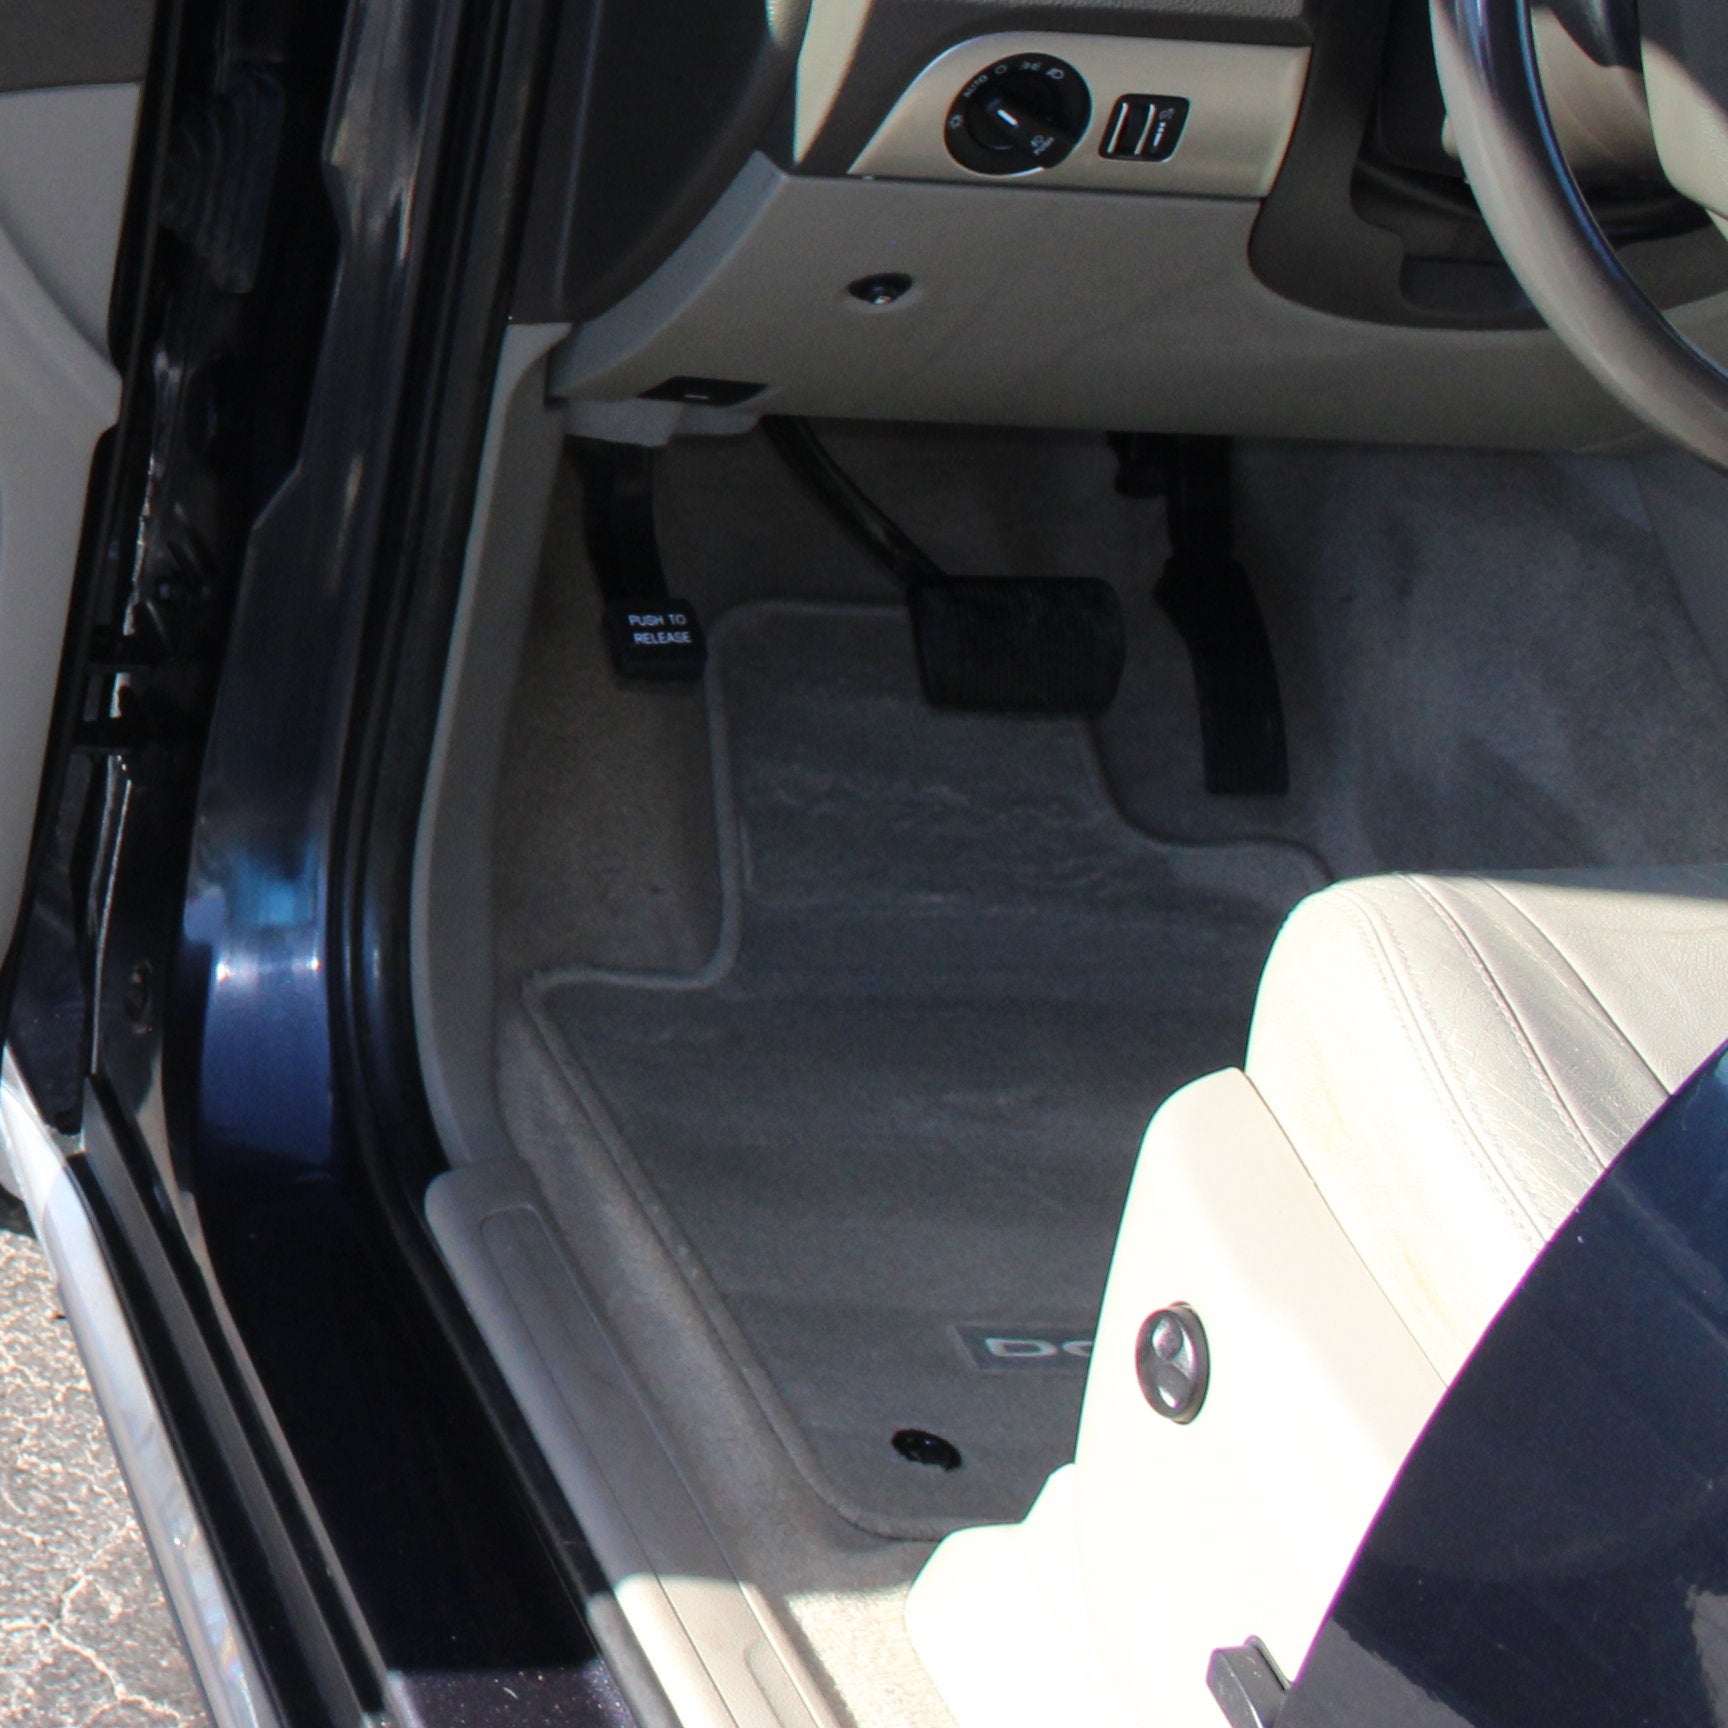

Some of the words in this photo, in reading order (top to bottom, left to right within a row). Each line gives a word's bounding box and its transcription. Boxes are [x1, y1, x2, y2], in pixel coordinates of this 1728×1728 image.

[628, 614, 664, 626] PUSH
[667, 614, 687, 625] TO
[633, 631, 693, 645] RELEASE
